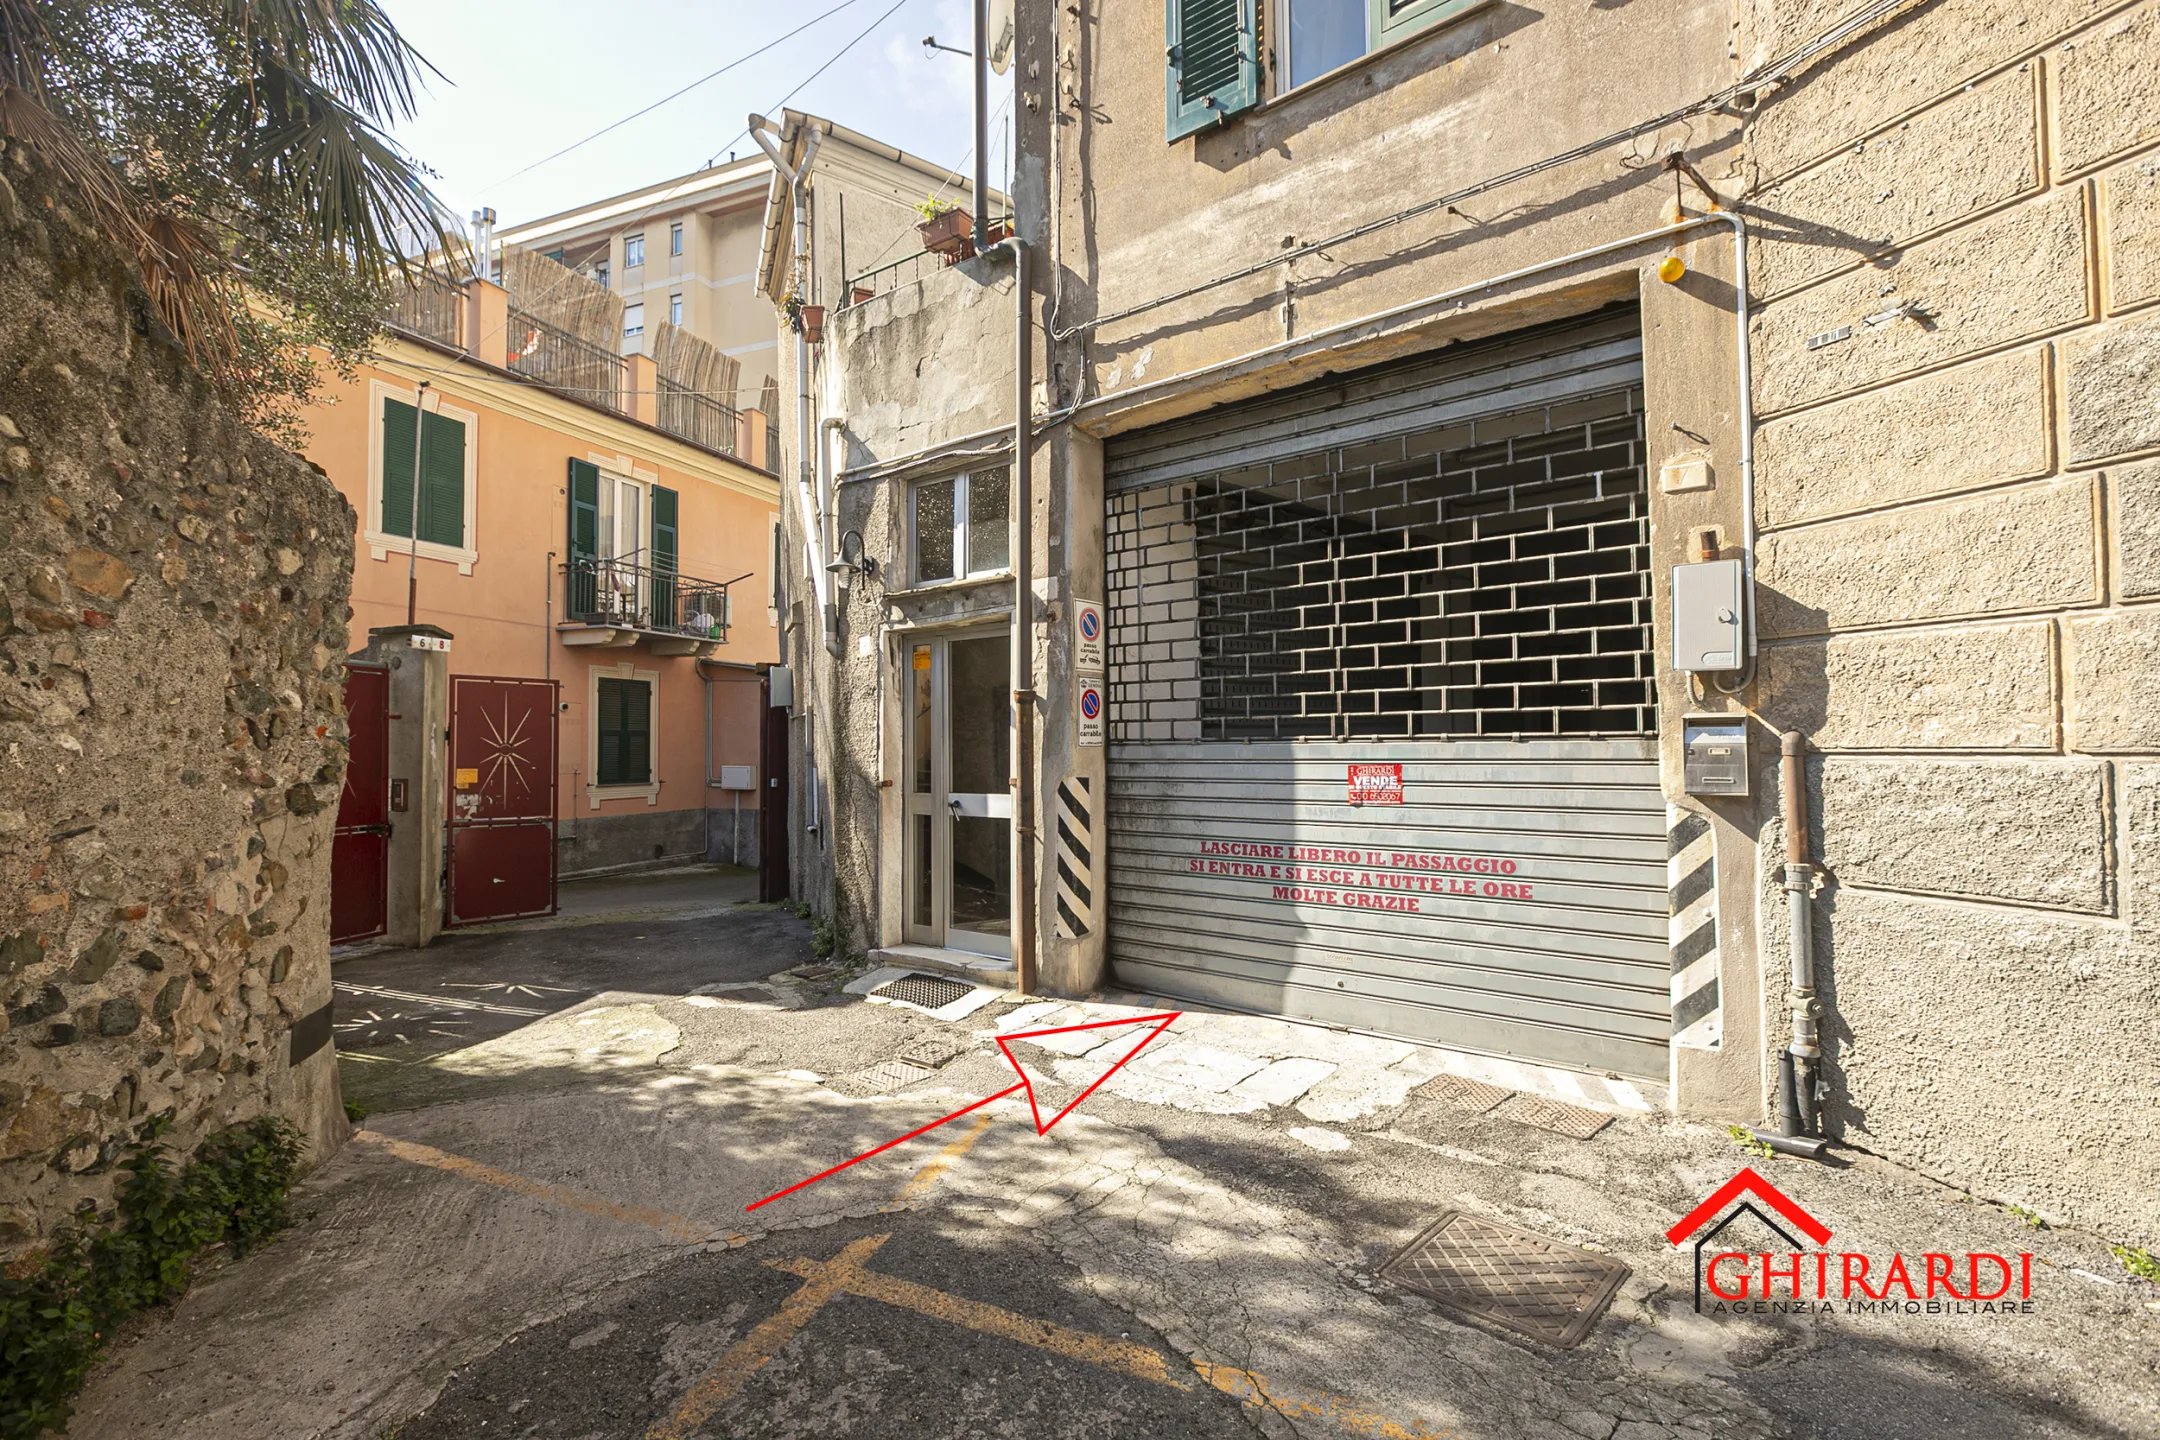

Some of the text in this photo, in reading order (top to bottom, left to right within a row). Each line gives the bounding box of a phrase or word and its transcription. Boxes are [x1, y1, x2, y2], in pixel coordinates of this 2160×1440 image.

[420, 638, 425, 647] 6
[439, 640, 444, 649] 8
[1353, 776, 1398, 785] VENDE
[1200, 841, 1517, 875] LASCIARE LIBERO IL PASSAGGIO
[1190, 859, 1533, 899] SI ENTRA E SI ESCE A TUTTE LE ORE
[1273, 886, 1420, 912] MOLTE GRAZIE
